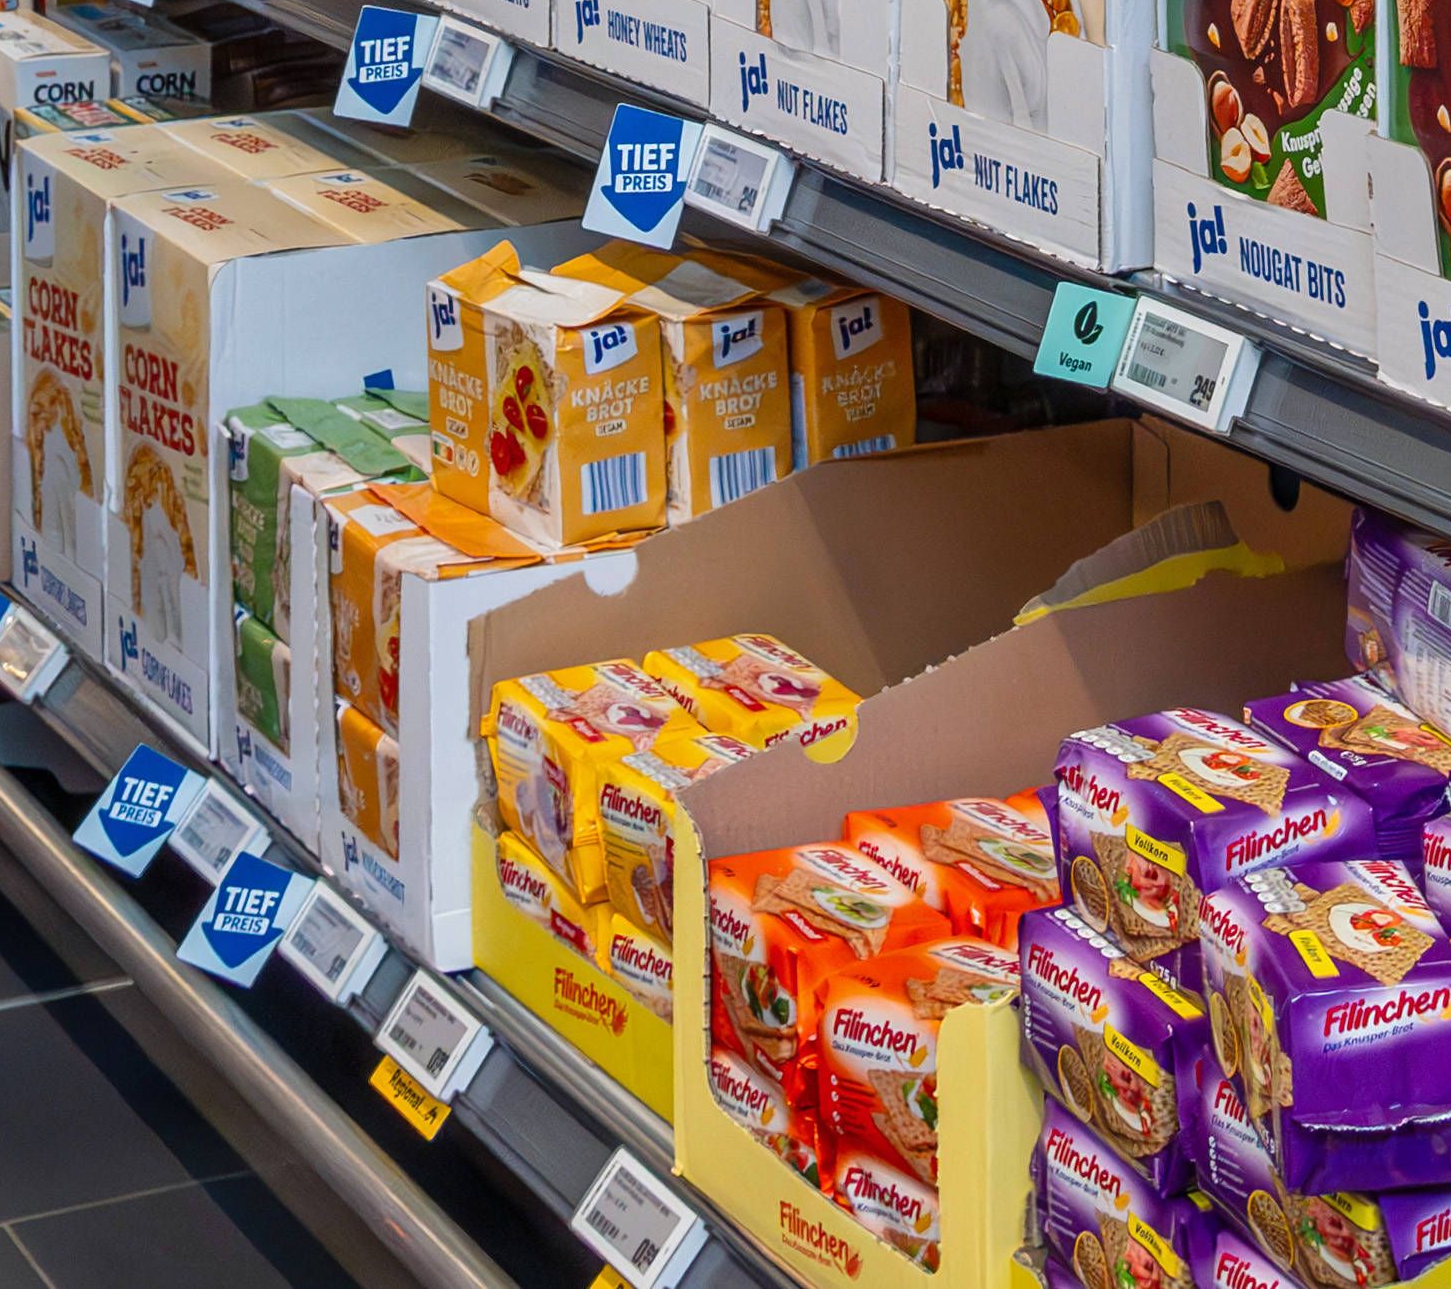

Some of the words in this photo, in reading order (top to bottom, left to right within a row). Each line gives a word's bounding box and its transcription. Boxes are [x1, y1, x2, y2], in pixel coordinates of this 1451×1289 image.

[607, 7, 640, 45] HONEY
[644, 17, 688, 64] WHEATS
[974, 154, 1002, 188] NUT
[1005, 162, 1059, 215] FLAKES
[123, 344, 182, 405] CORN
[569, 373, 652, 407] KNÄCKE
[585, 398, 635, 425] BROT
[223, 887, 280, 915] TIEF
[223, 914, 270, 936] PREIS
[1322, 985, 1451, 1037] Filinchen
